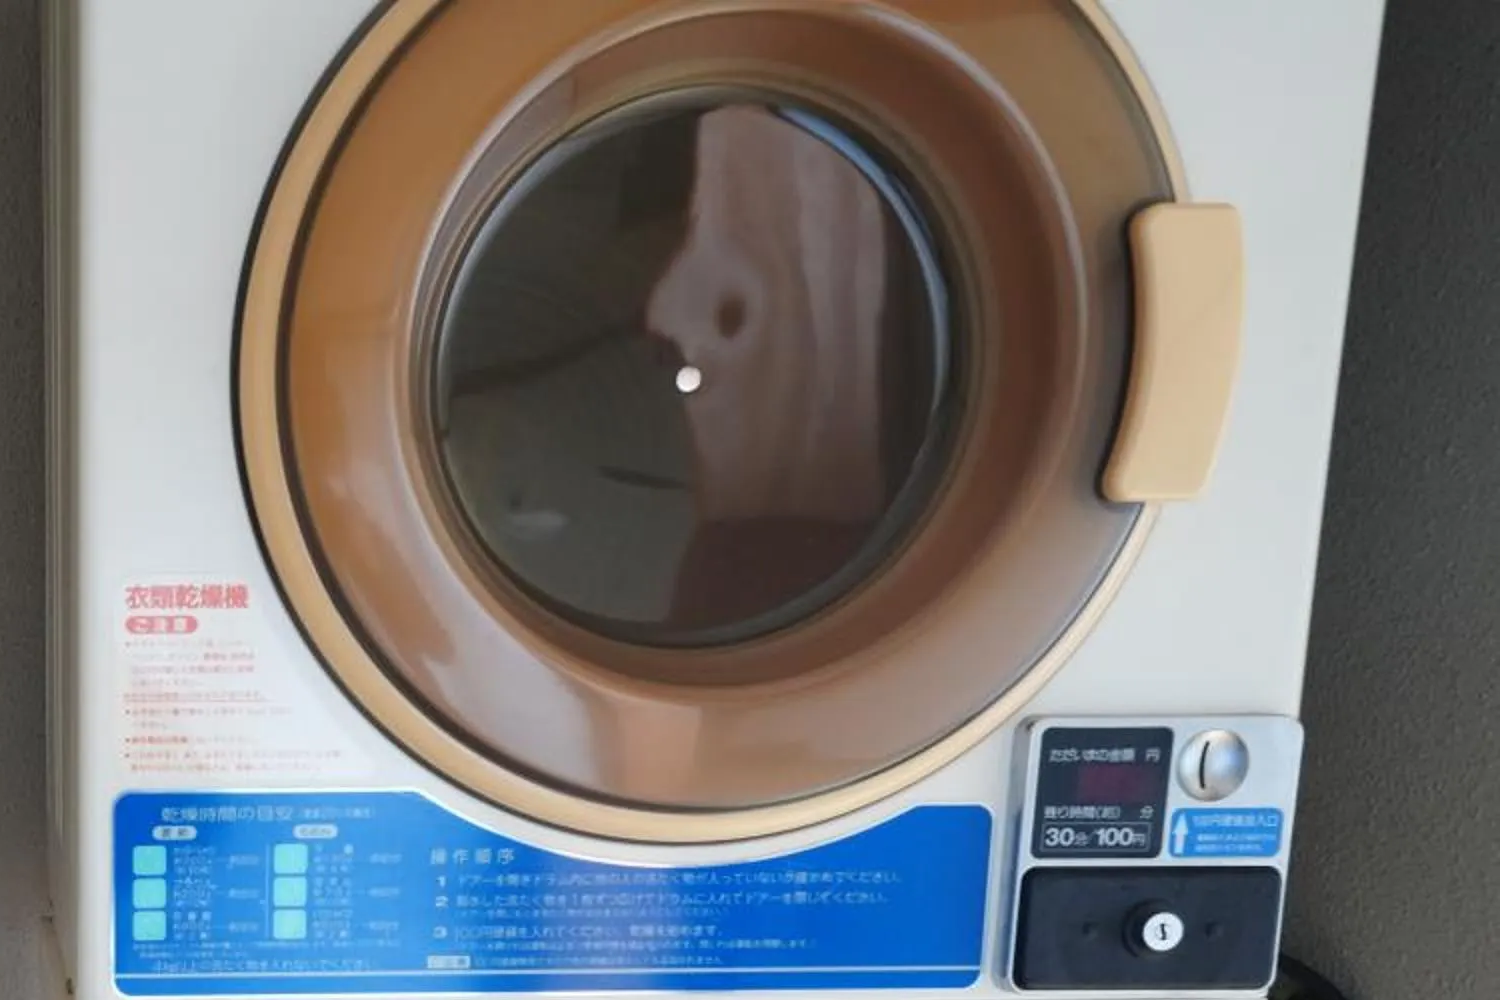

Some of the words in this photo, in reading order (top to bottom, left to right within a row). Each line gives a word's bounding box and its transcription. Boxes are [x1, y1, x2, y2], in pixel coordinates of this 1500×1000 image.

[125, 584, 249, 609] 衣類乾燥機
[1145, 748, 1161, 762] 円
